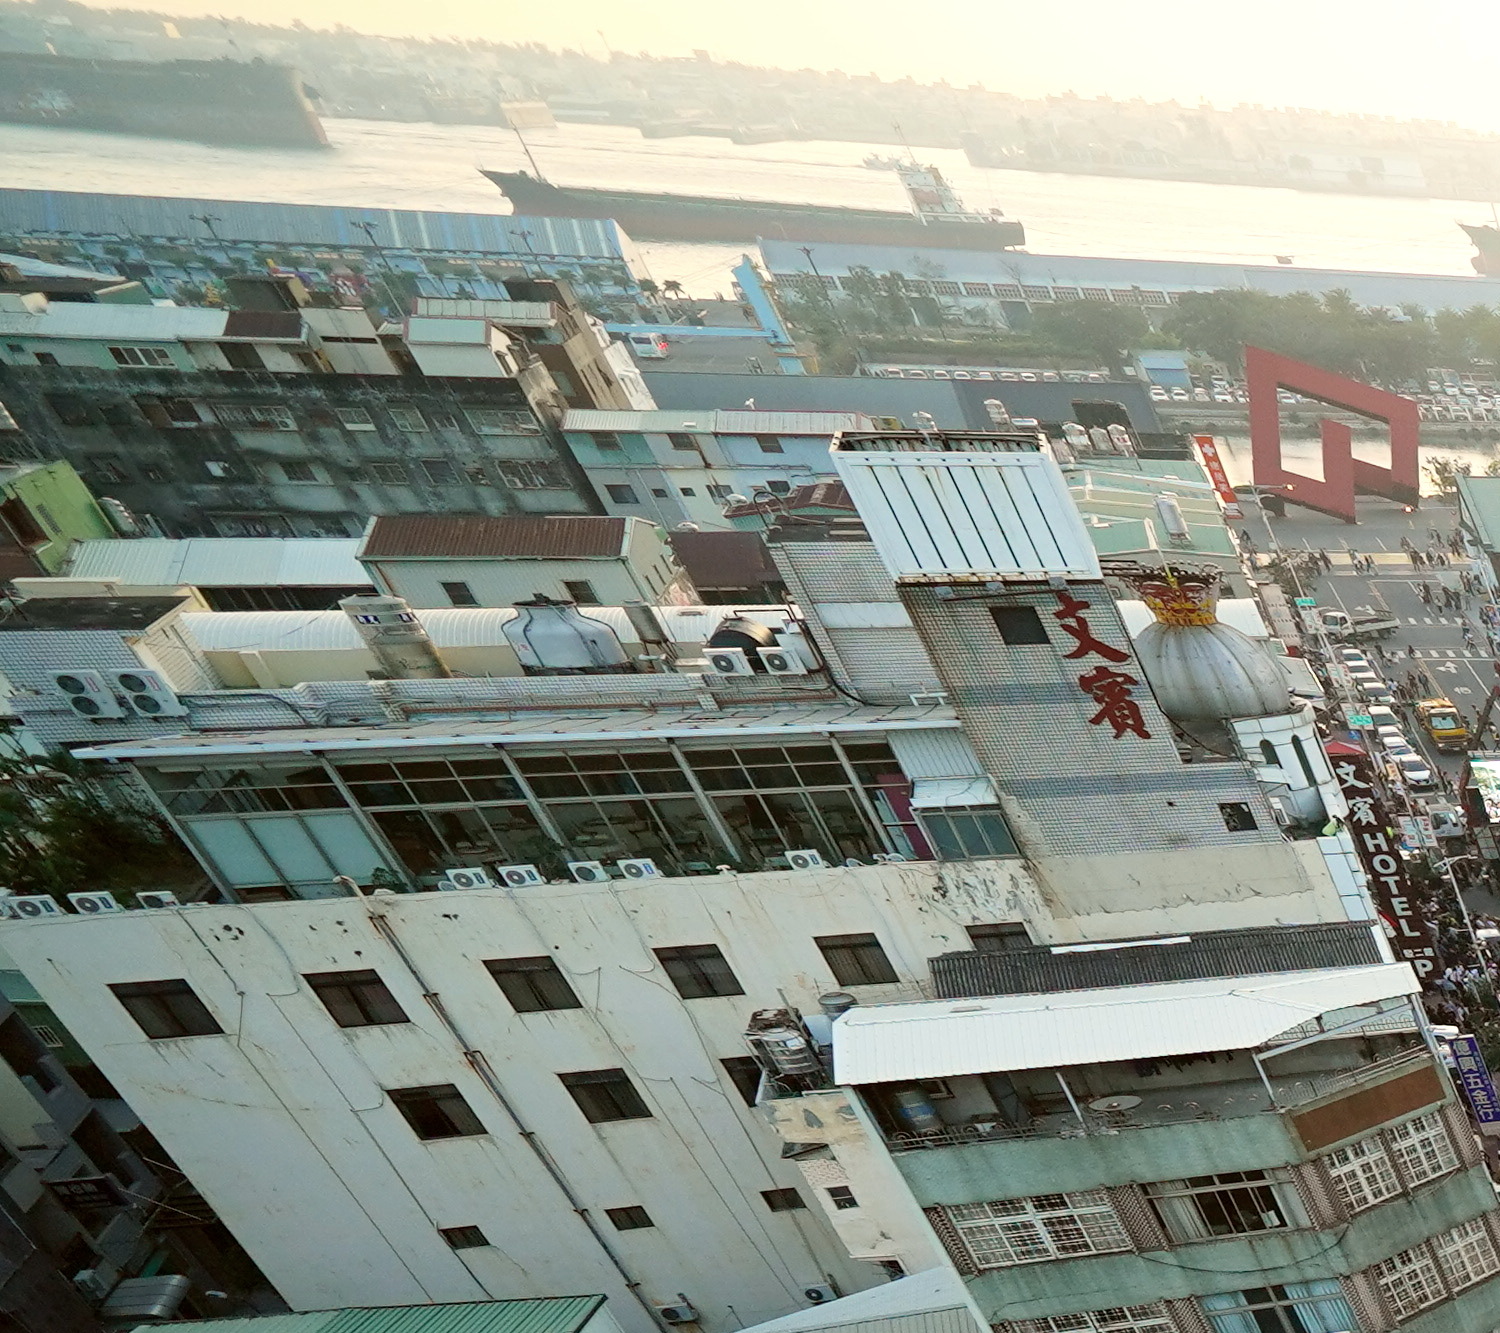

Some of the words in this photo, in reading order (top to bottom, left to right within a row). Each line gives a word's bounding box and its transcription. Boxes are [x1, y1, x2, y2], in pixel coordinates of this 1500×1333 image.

[1053, 591, 1151, 739] 文賓
[1335, 761, 1379, 826] 文賓
[1362, 832, 1420, 938] HOTEL
